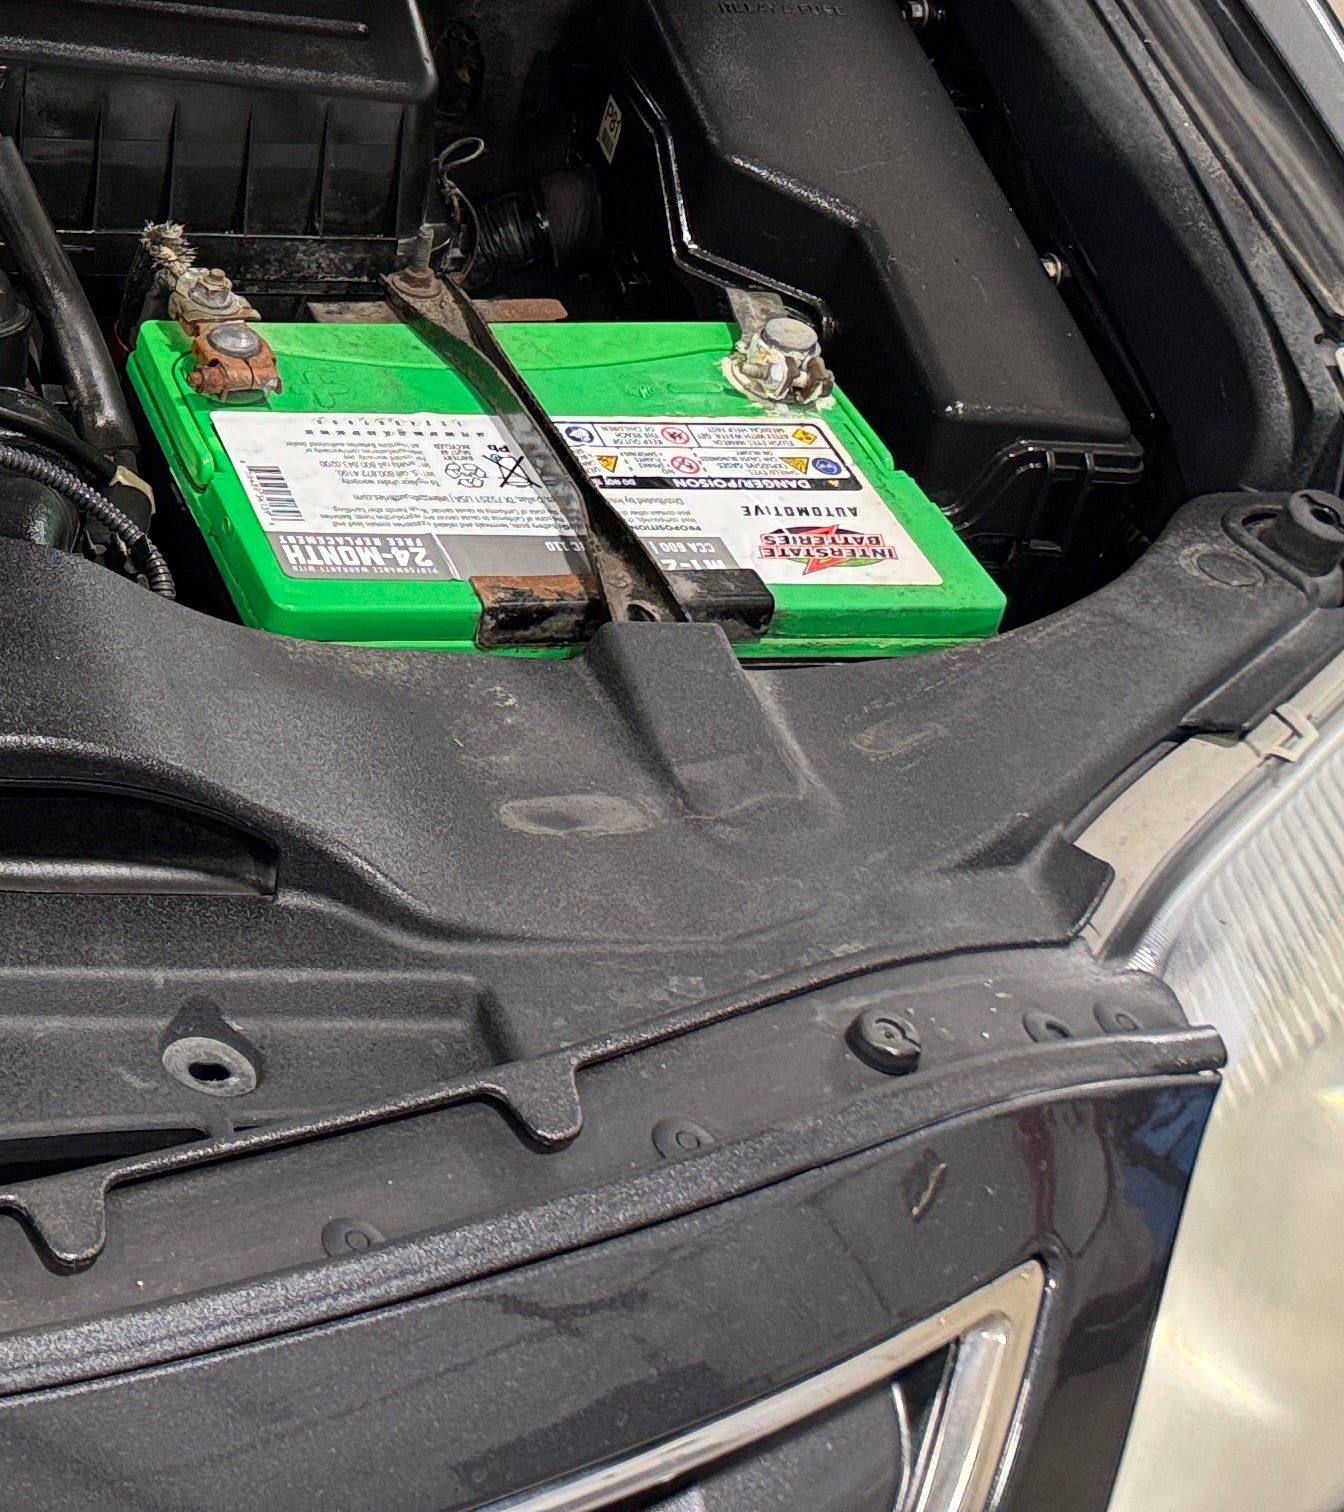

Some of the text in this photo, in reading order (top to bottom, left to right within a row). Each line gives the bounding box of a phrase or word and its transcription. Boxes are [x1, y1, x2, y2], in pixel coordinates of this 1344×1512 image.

[486, 444, 509, 454] Pb
[671, 477, 813, 489] DANGER/POISON
[740, 504, 858, 517] AUTOMOTIVE
[278, 535, 423, 546] FREE REPLACEMENT
[761, 534, 881, 546] BATTERIES
[659, 542, 716, 553] CCA 600
[760, 546, 896, 559] INTERSTATE
[281, 544, 434, 567] 24-MONTH
[292, 565, 438, 575] PERFORMANCE WARRANTY WITH
